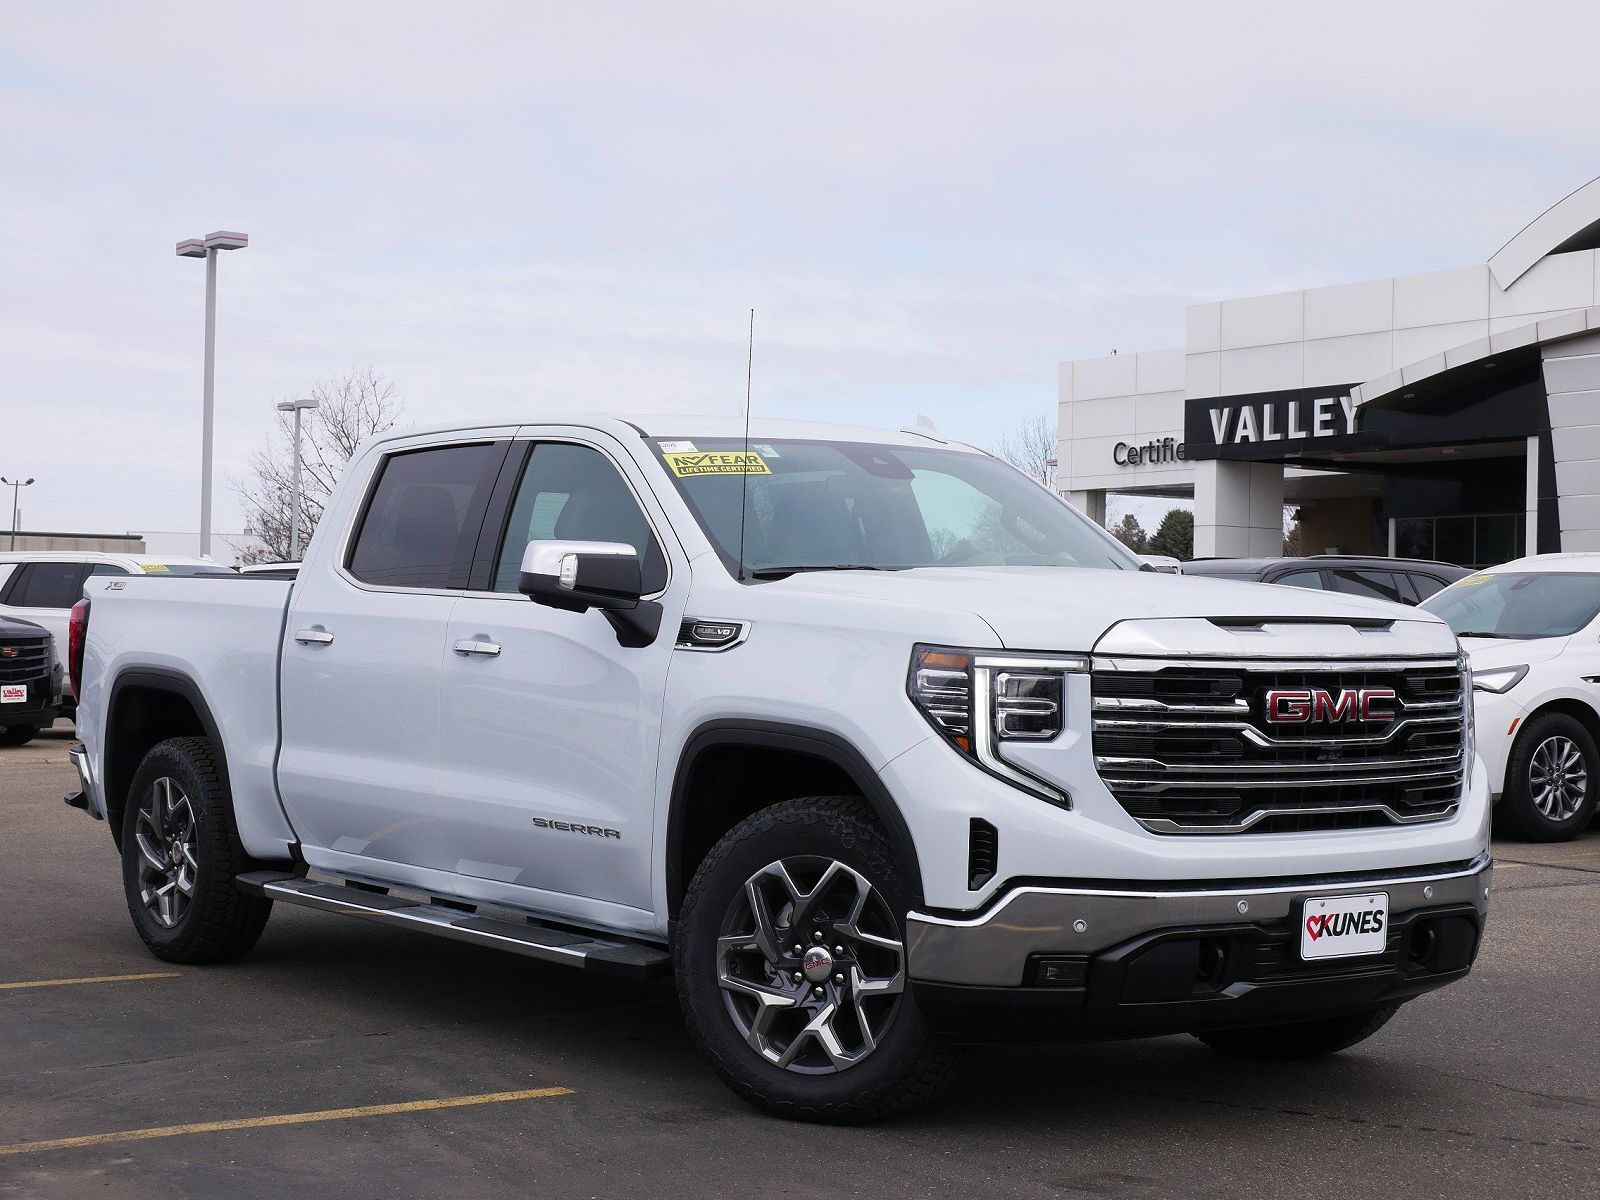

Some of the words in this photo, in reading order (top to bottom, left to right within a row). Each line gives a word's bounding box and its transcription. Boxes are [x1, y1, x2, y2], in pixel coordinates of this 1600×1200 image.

[1209, 396, 1358, 445] VALLEY
[680, 465, 720, 474] LIFETIME
[709, 455, 760, 465] FEAR
[1265, 689, 1396, 723] GMC
[532, 816, 621, 839] SIERRA
[1318, 909, 1384, 937] KUNES
[805, 957, 830, 970] GMC
